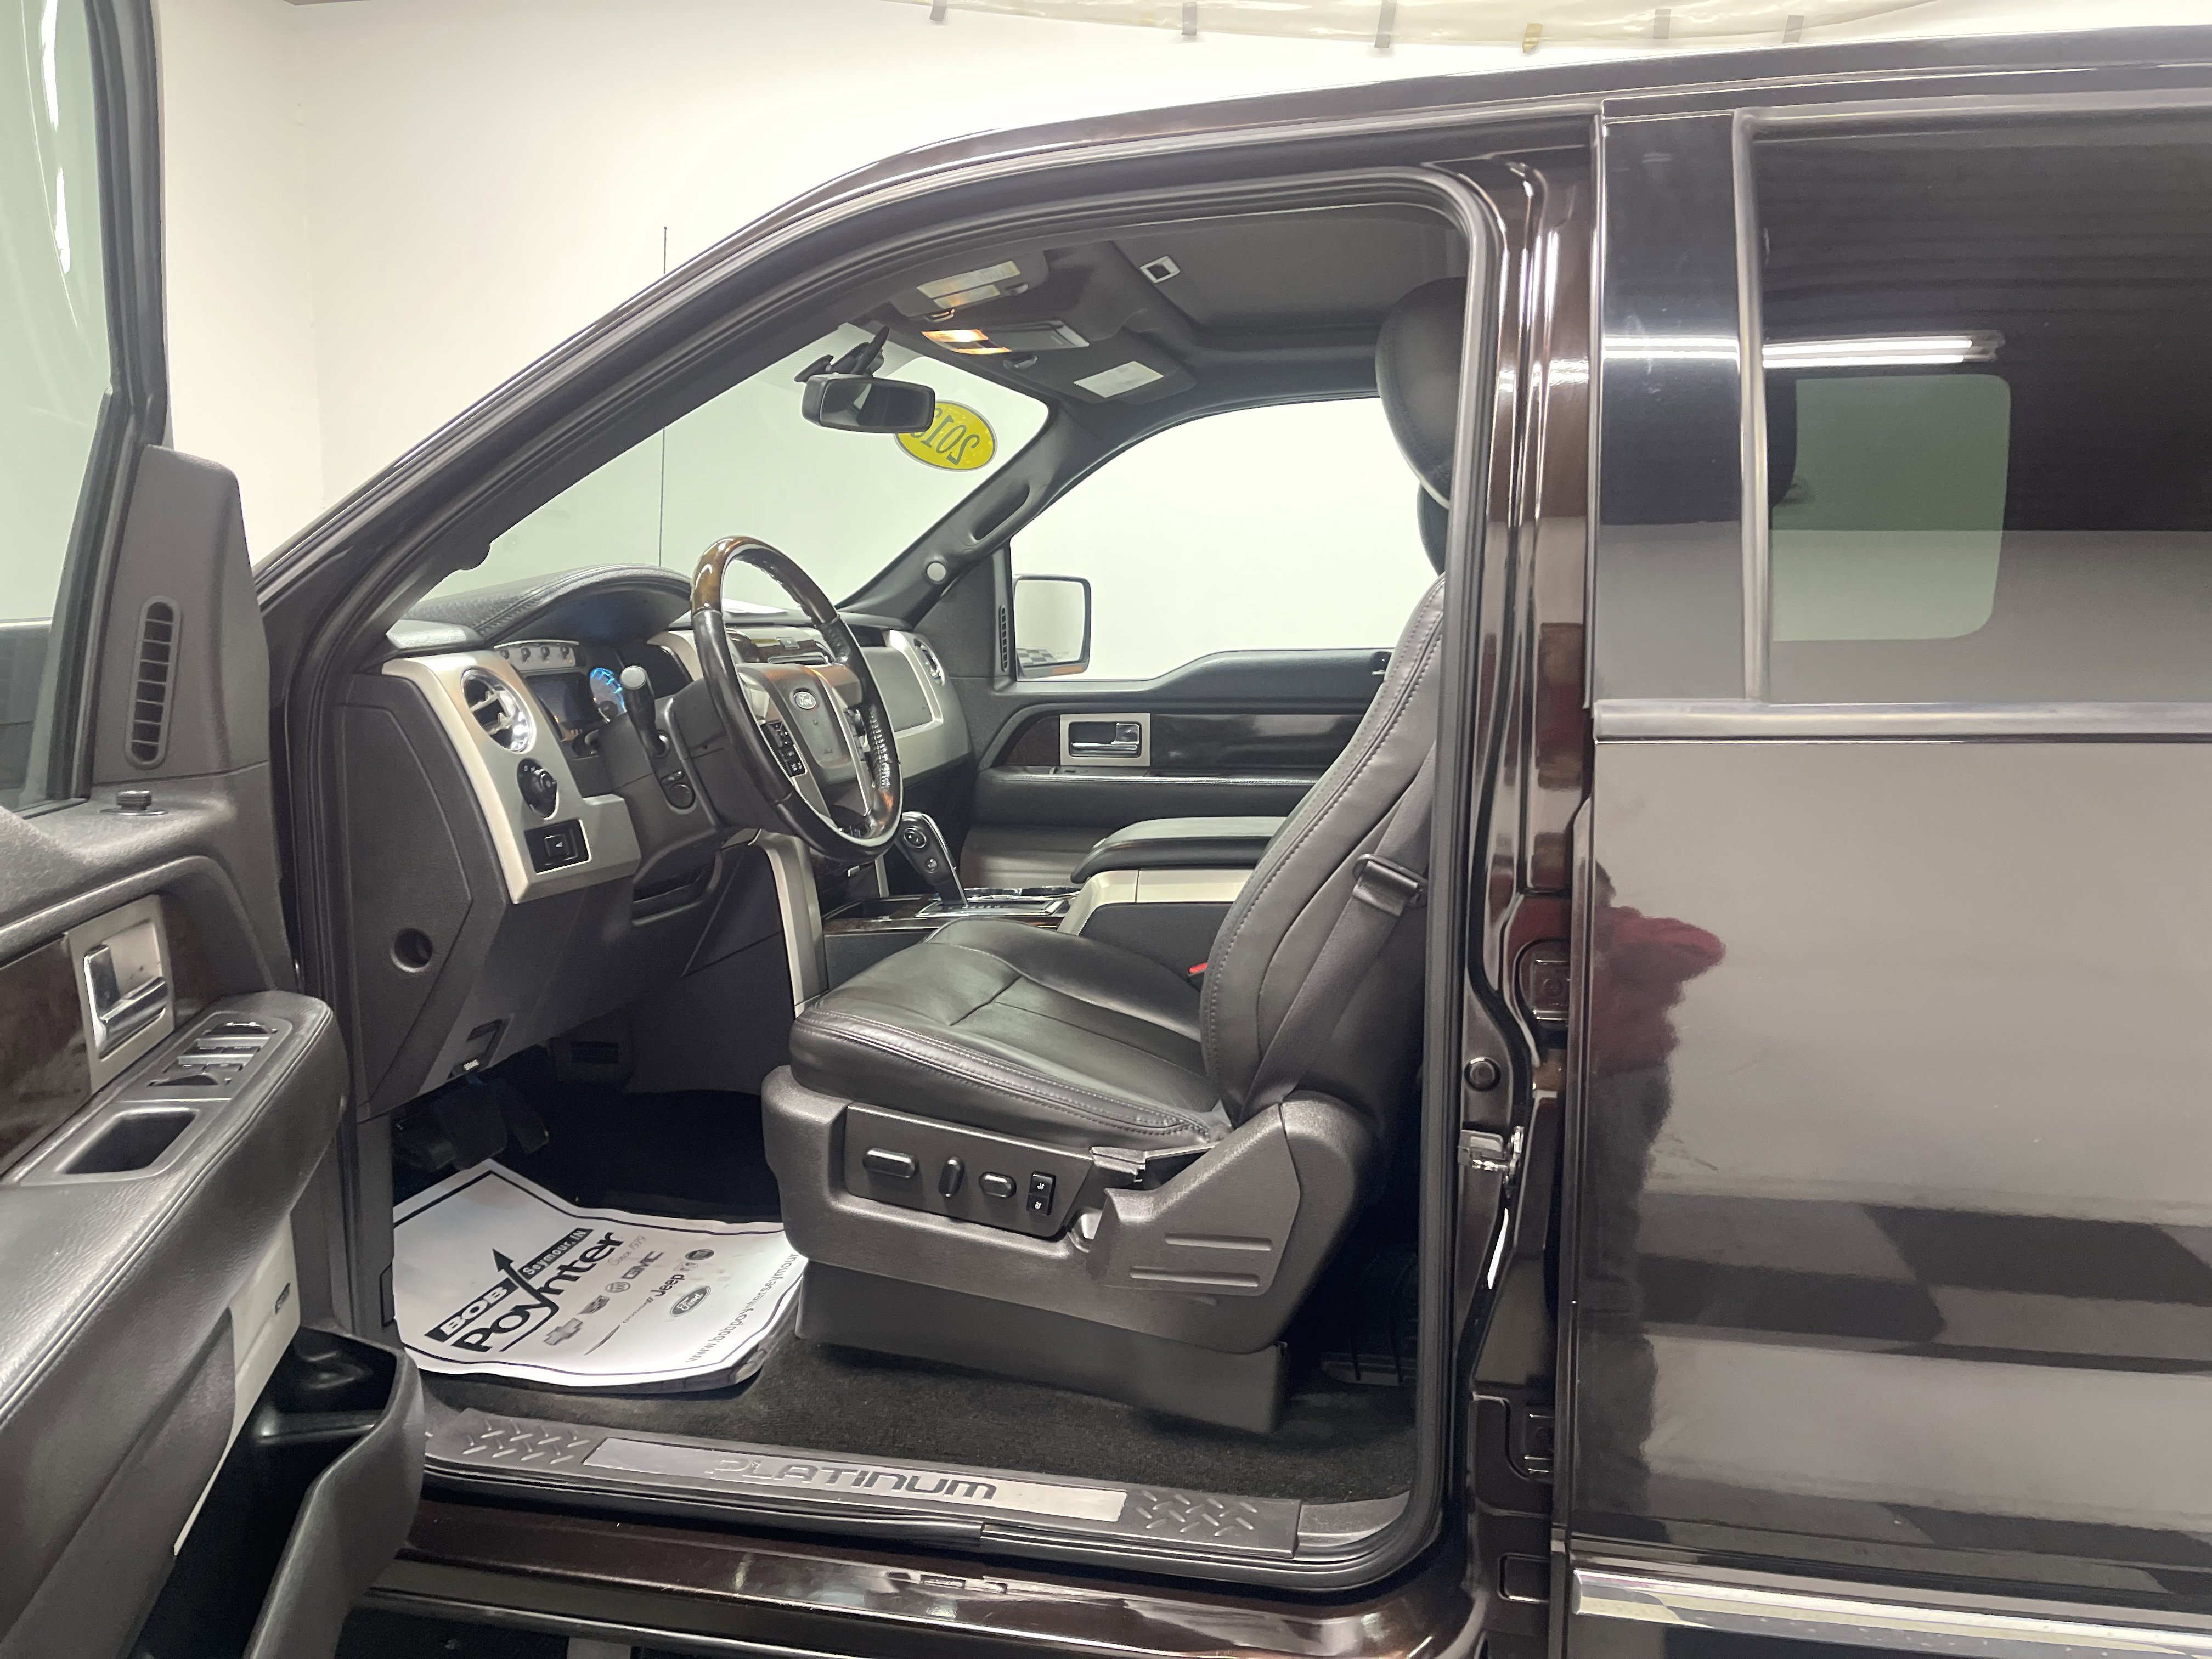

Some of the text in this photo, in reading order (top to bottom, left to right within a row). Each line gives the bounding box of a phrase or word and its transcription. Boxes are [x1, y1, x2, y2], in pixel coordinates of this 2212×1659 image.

[570, 1230, 586, 1240] IN
[620, 1250, 665, 1279] GMC
[650, 1274, 686, 1296] Jeep
[439, 1286, 508, 1335] BOB
[704, 1458, 997, 1500] PLATINUM
